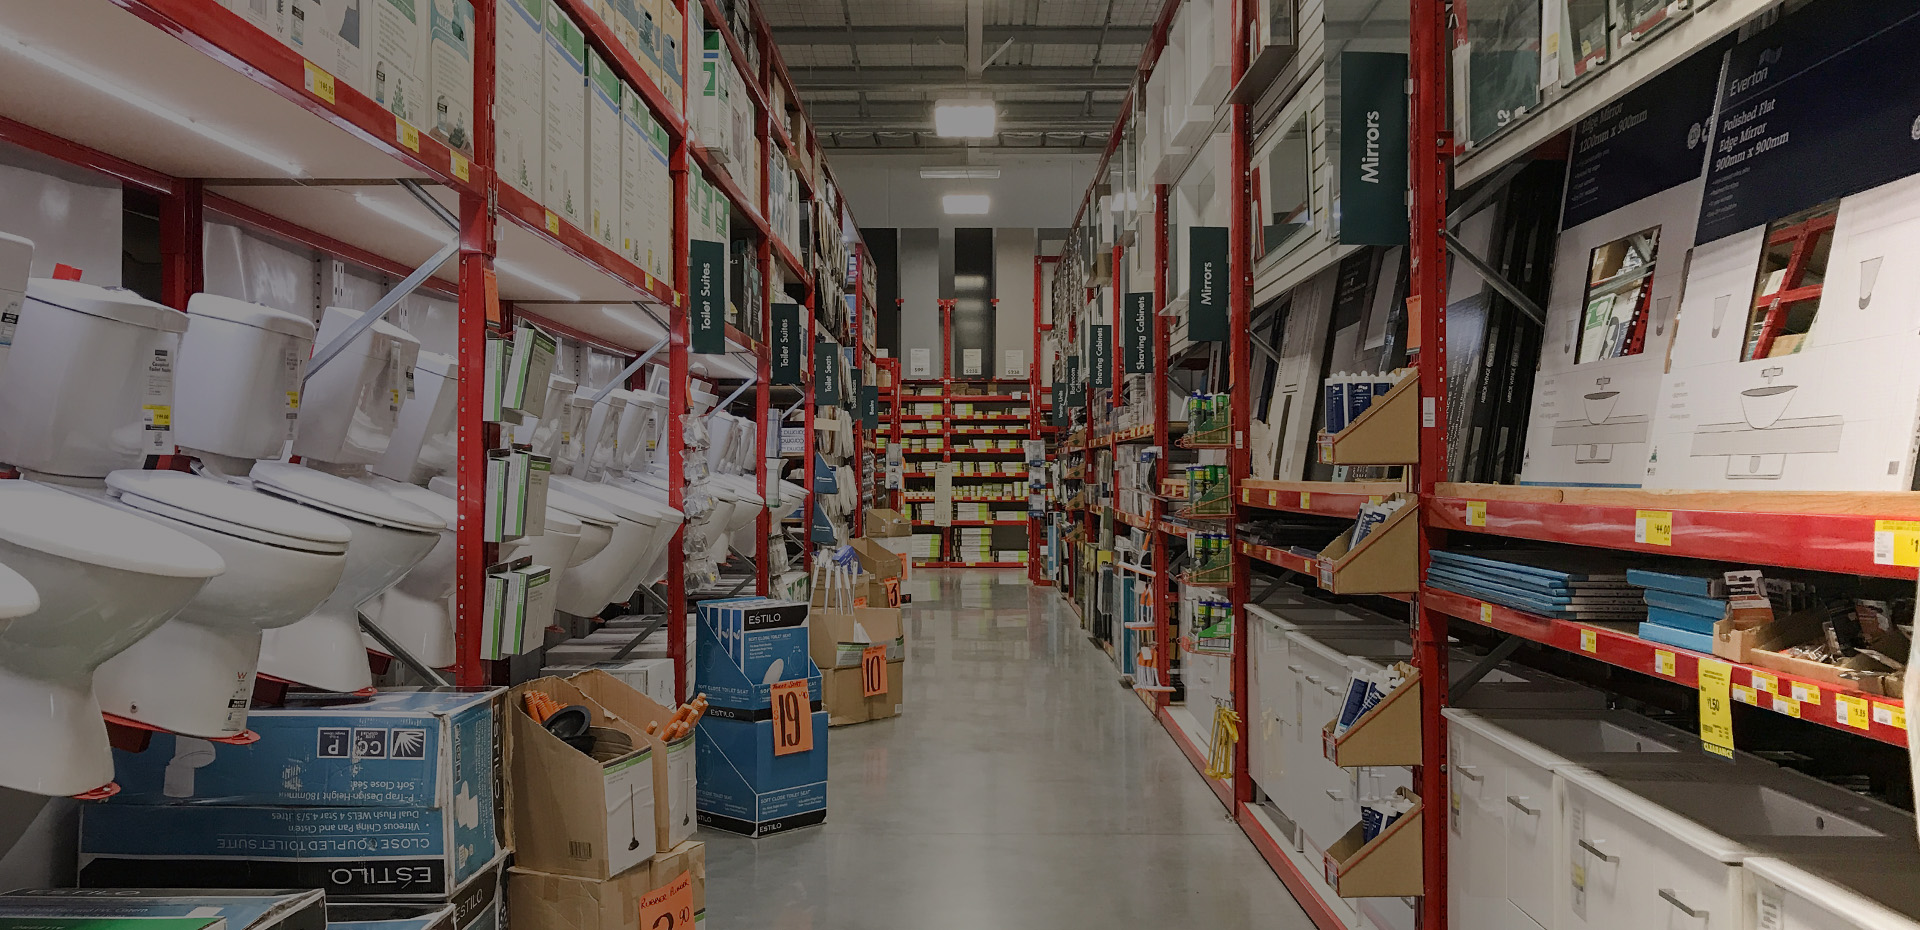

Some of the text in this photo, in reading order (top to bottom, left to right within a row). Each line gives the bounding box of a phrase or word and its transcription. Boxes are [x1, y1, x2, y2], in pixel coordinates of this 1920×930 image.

[1729, 67, 1768, 97] Everton
[1582, 102, 1624, 134] Edge Mirror
[1722, 98, 1776, 133] Polished Flat
[1578, 130, 1610, 154] 1200mm
[1617, 110, 1648, 134] 900mm
[1719, 122, 1768, 153] Edge Mirror
[1361, 110, 1380, 184] Mirrors
[1714, 132, 1790, 172] 900mm x 900mm
[1200, 262, 1212, 306] Mirrors
[701, 262, 711, 330] Toilet Suites
[1136, 296, 1146, 370] Shaving Cabinets
[780, 318, 788, 368] Toilet Suites
[1096, 356, 1104, 385] Shaving
[866, 656, 880, 692] 10
[779, 691, 802, 748] 19
[328, 740, 338, 754] P
[1703, 741, 1734, 760] CLEARANCE
[351, 781, 414, 790] Soft Close Seat
[386, 792, 414, 802] P-Trap
[320, 812, 338, 820] Star
[340, 812, 346, 820] 4
[348, 812, 372, 820] WELS
[374, 811, 396, 820] Flush
[403, 811, 420, 820] Dual
[319, 823, 336, 832] and
[338, 823, 354, 832] Pan
[356, 822, 382, 832] China
[384, 822, 420, 831] Vitreous
[216, 838, 258, 850] SUITE
[260, 838, 306, 850] TOILET
[381, 838, 430, 850] CLOSE
